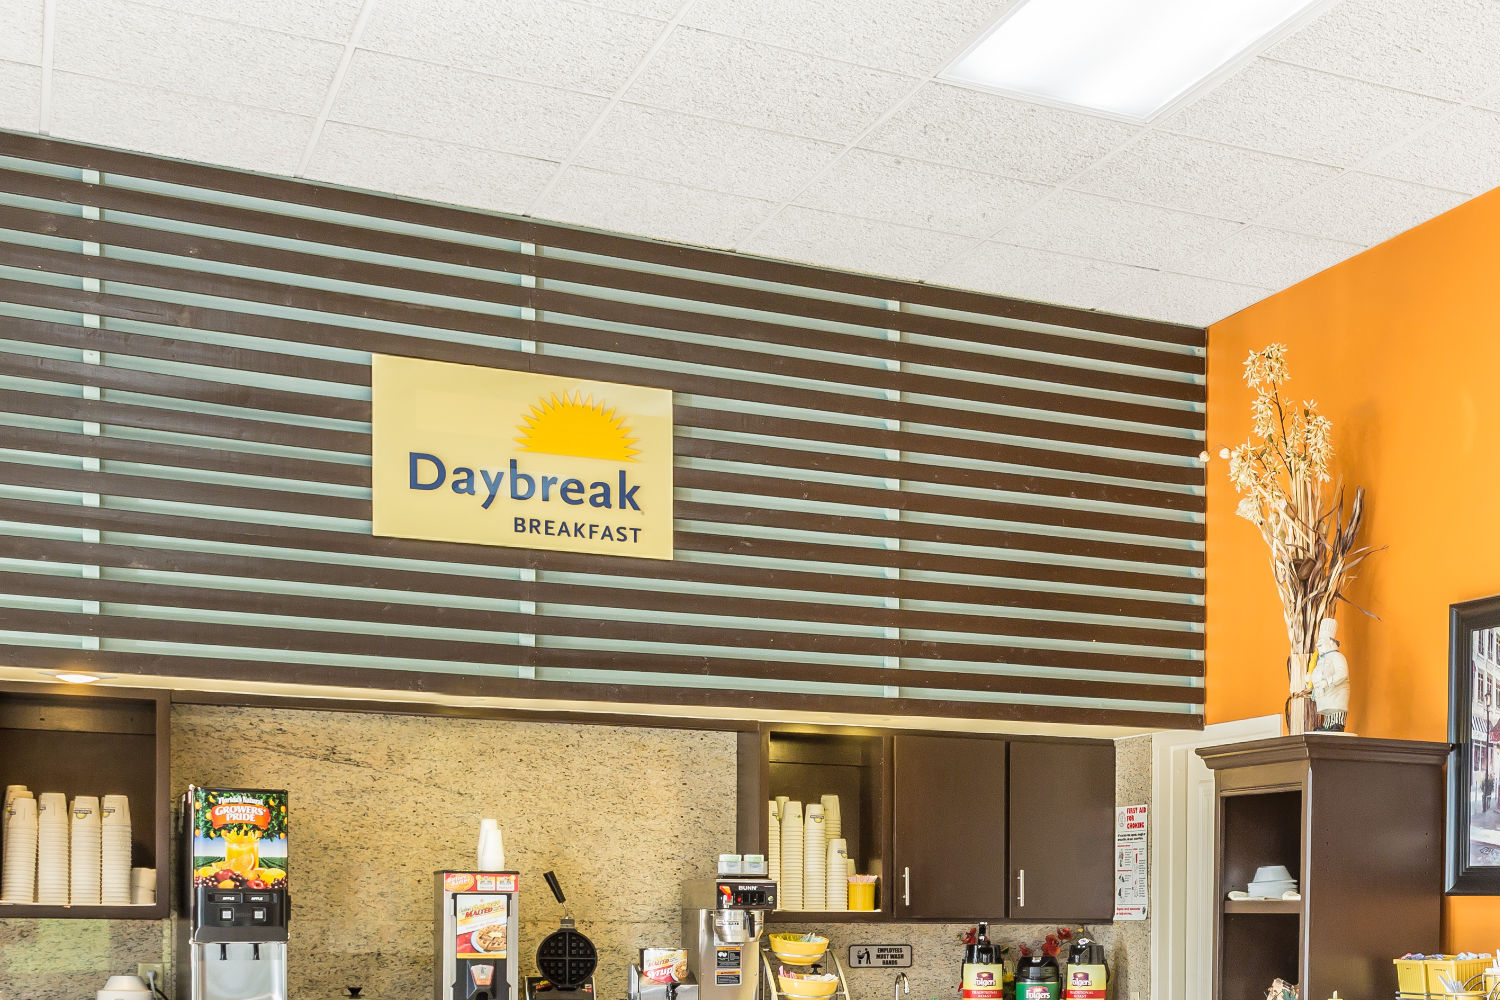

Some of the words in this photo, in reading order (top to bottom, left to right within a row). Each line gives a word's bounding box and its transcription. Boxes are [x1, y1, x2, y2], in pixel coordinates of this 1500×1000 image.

[408, 451, 641, 511] Daybreak
[513, 517, 642, 543] BREAKFAST
[1138, 806, 1146, 814] AID
[226, 813, 256, 822] PRIDE
[1025, 989, 1051, 1000] Folgers
